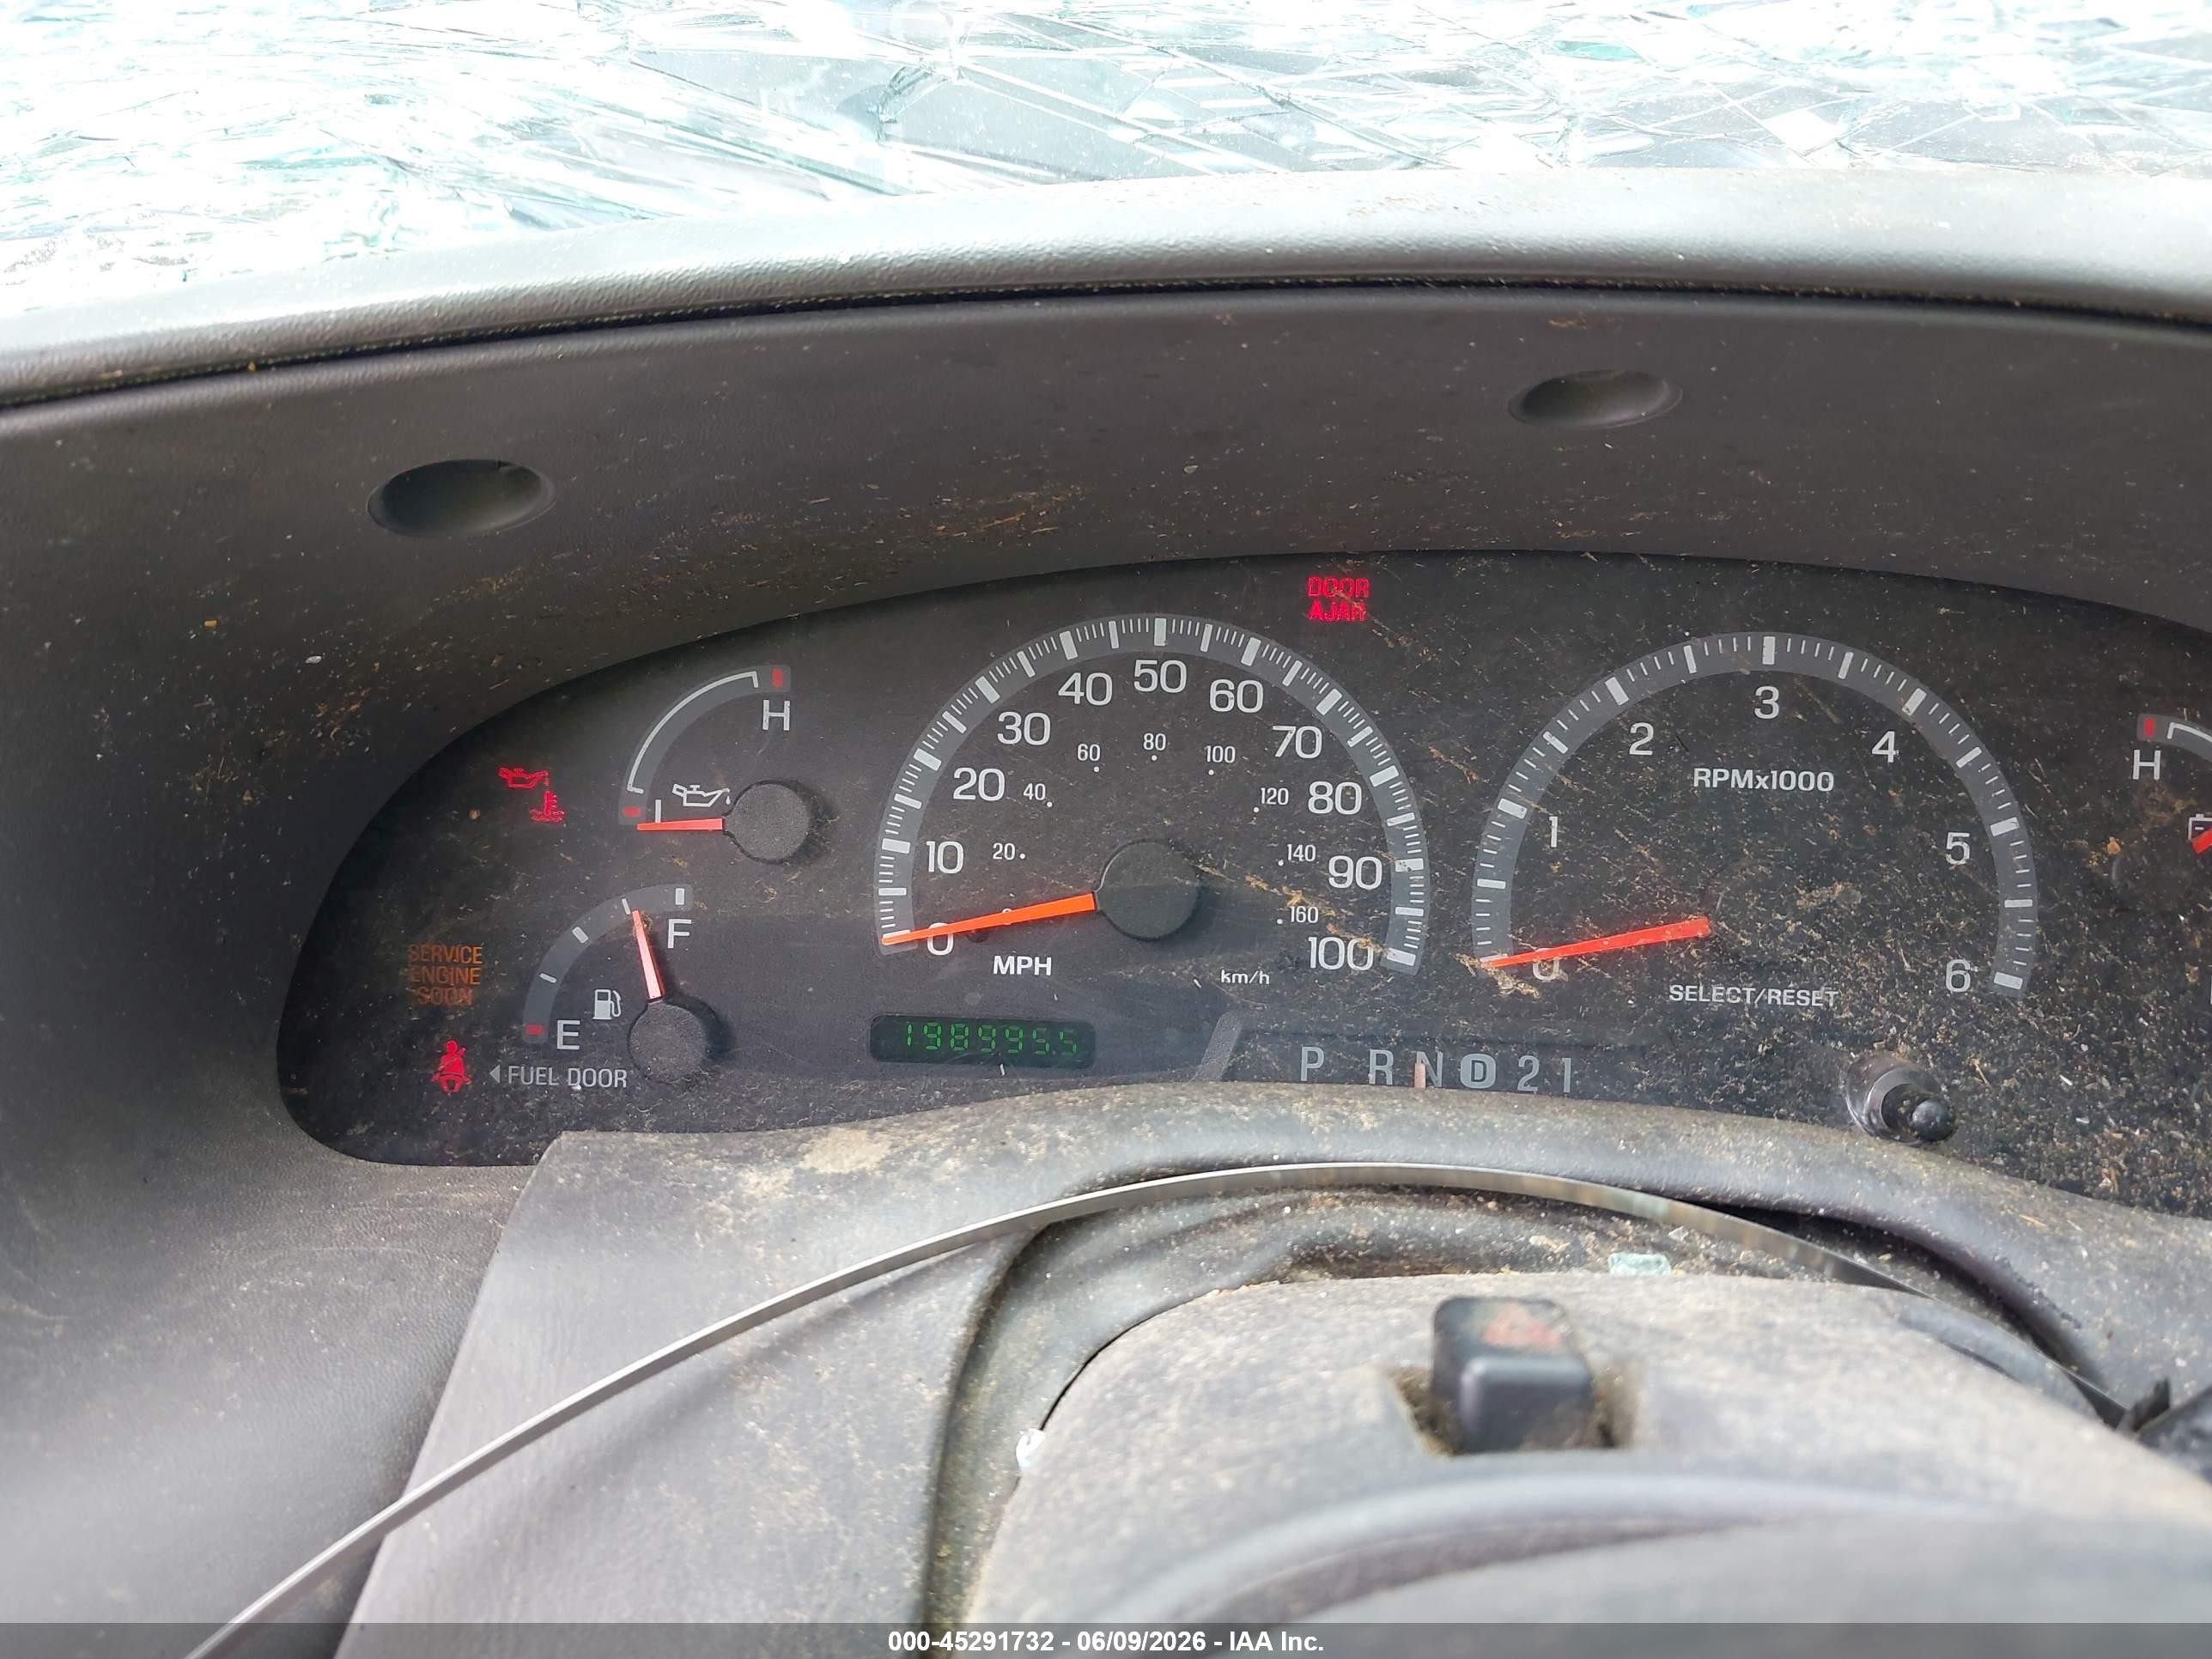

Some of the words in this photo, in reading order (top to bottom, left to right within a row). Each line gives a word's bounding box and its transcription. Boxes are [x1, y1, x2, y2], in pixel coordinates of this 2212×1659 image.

[1308, 577, 1369, 598] DOOR
[1308, 601, 1366, 621] AJAR
[1058, 672, 1113, 706] 40
[1133, 659, 1187, 694] 50
[1209, 678, 1264, 714] 60
[1754, 685, 1780, 720] 3
[762, 699, 791, 731] H
[997, 711, 1051, 745] 30
[1077, 743, 1101, 763] 60
[1143, 732, 1166, 752] 80
[1206, 744, 1236, 764] 100
[1272, 725, 1322, 759] 70
[1629, 722, 1654, 756] 2
[1871, 731, 1898, 763] 4
[1693, 768, 1834, 792] RPMx1000
[2132, 749, 2161, 781] H
[953, 767, 1006, 801] 20
[1023, 782, 1046, 801] 40
[1261, 787, 1289, 805] 120
[1308, 781, 1362, 815] 80
[1548, 816, 1559, 848] 1
[926, 841, 964, 874] 10
[993, 842, 1017, 860] 20
[1287, 843, 1316, 862] 140
[1945, 831, 1971, 866] 5
[1328, 855, 1382, 890] 90
[1290, 905, 1319, 925] 160
[667, 918, 692, 949] F
[927, 922, 954, 956] 0
[408, 945, 483, 964] SERVICE
[993, 955, 1052, 976] MPH
[1308, 936, 1374, 971] 100
[410, 965, 482, 985] ENGINE
[1220, 969, 1270, 985] km/h
[1945, 958, 1972, 993] 6
[416, 987, 472, 1006] SOON
[1668, 984, 1839, 1007] SELECT/RESET
[556, 1019, 580, 1050] E
[507, 1065, 560, 1086] FUEL
[568, 1067, 628, 1091] DOOR
[1300, 1046, 1325, 1082] P
[1369, 1048, 1395, 1086] R
[1417, 1050, 1443, 1088] N
[1516, 1054, 1540, 1092] 2
[1561, 1057, 1572, 1093] 1
